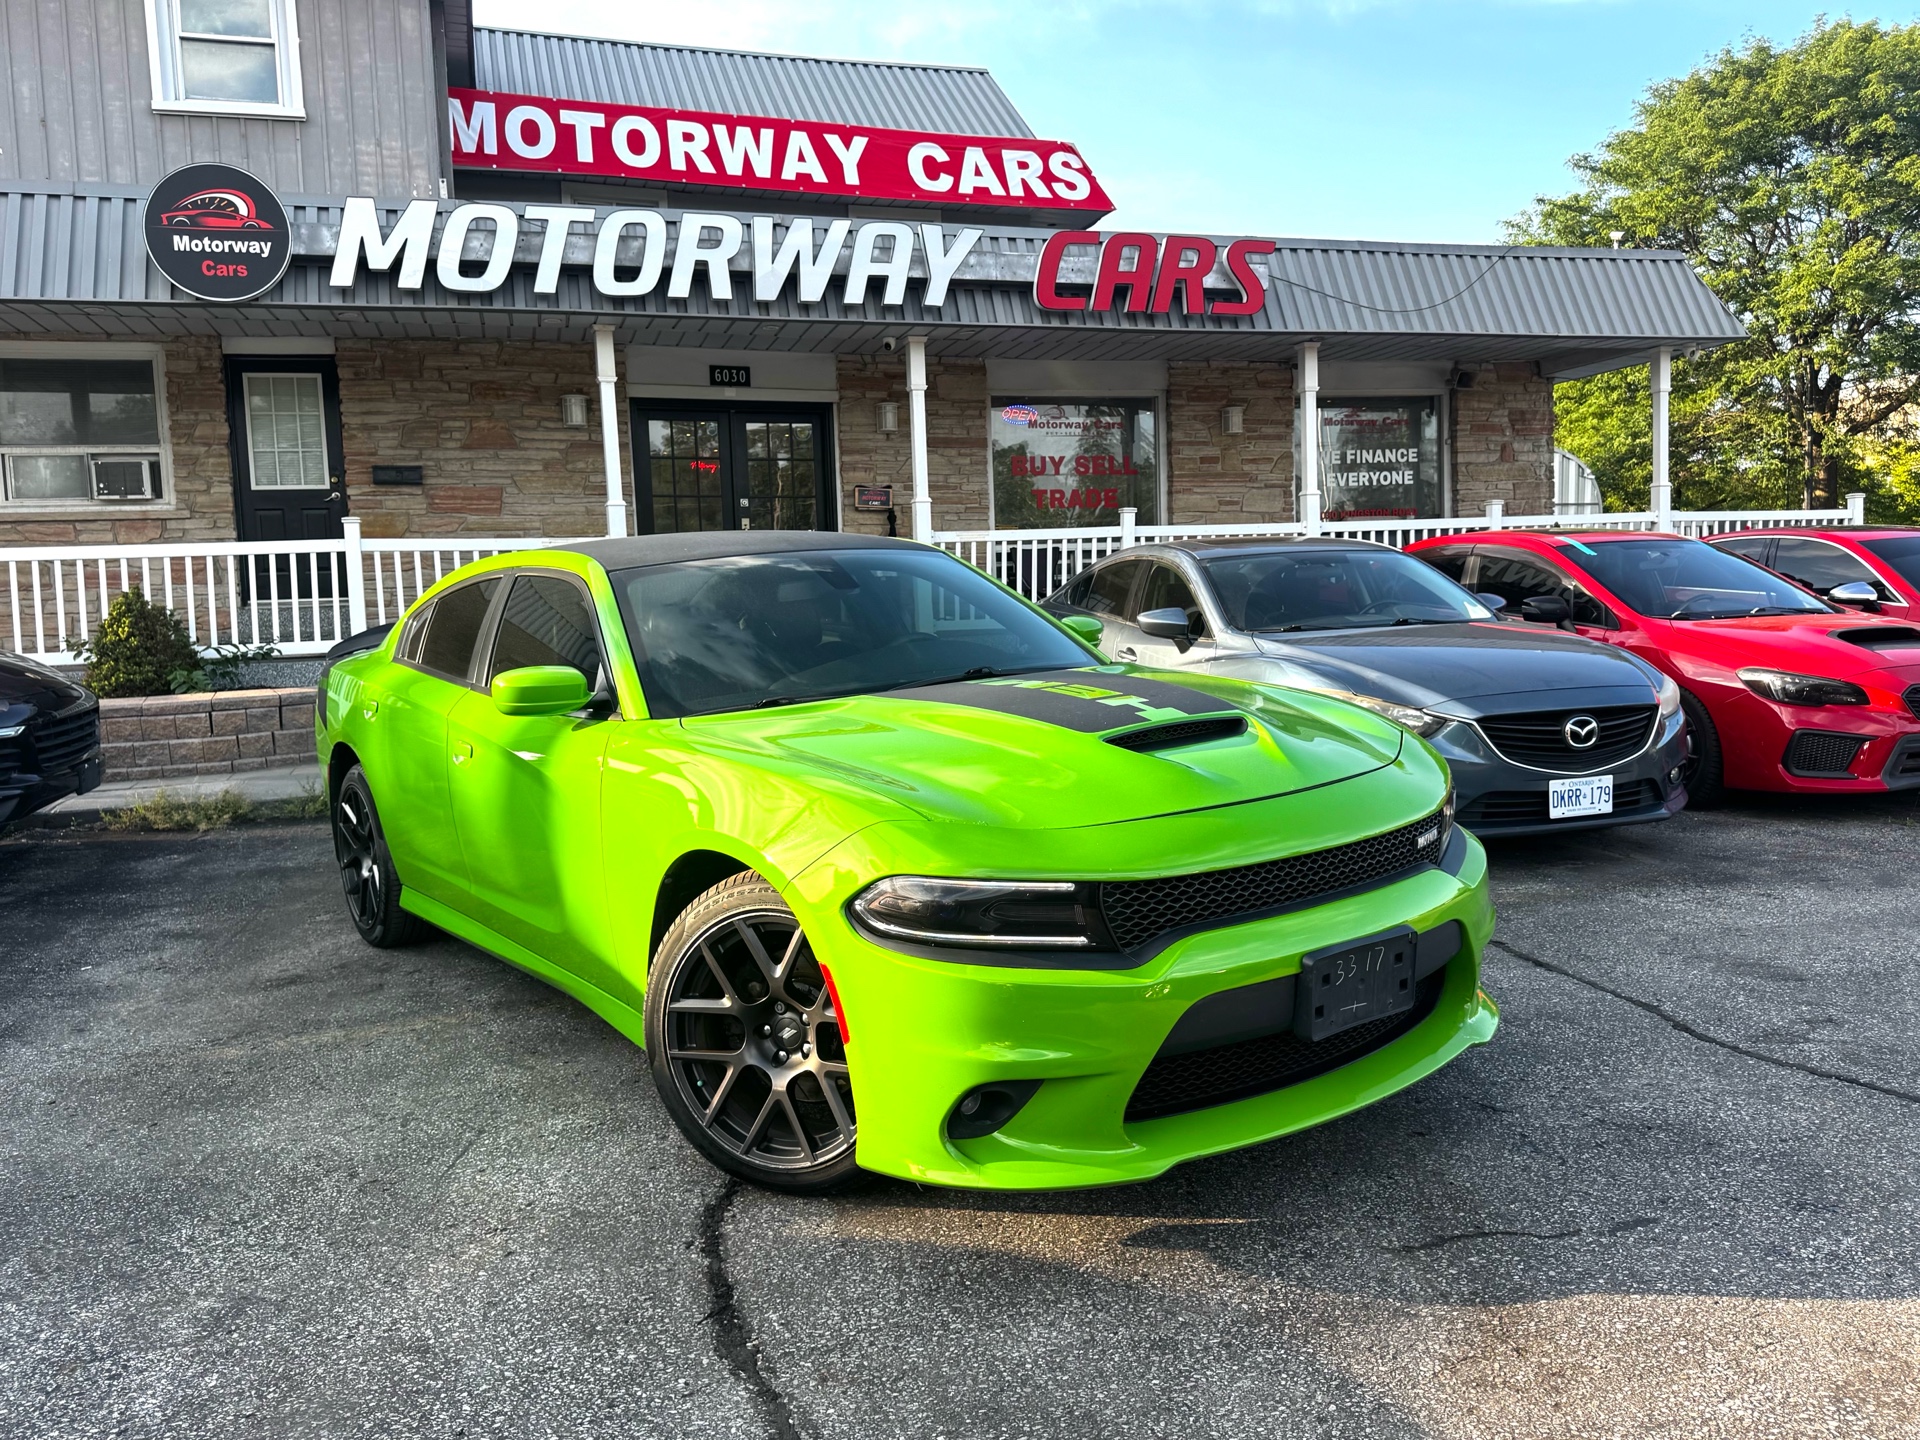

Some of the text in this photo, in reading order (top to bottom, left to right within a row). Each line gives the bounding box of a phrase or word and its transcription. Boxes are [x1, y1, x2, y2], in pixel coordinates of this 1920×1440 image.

[449, 97, 1090, 201] MOTORWAY CARS
[172, 234, 272, 258] Motorway
[329, 196, 1277, 315] MOTORWAY CARS
[201, 259, 248, 277] Cars
[714, 369, 746, 383] 6030
[1001, 407, 1038, 421] OPEN
[1324, 417, 1378, 427] Motorway
[1028, 418, 1124, 432] Motorway Cars
[1346, 448, 1418, 464] FINANCE
[1011, 455, 1139, 477] BUY SELL
[1327, 470, 1414, 486] EVERYONE
[1031, 488, 1119, 509] TRADE
[1552, 785, 1611, 809] DKRR 179
[1335, 946, 1385, 985] 3317
